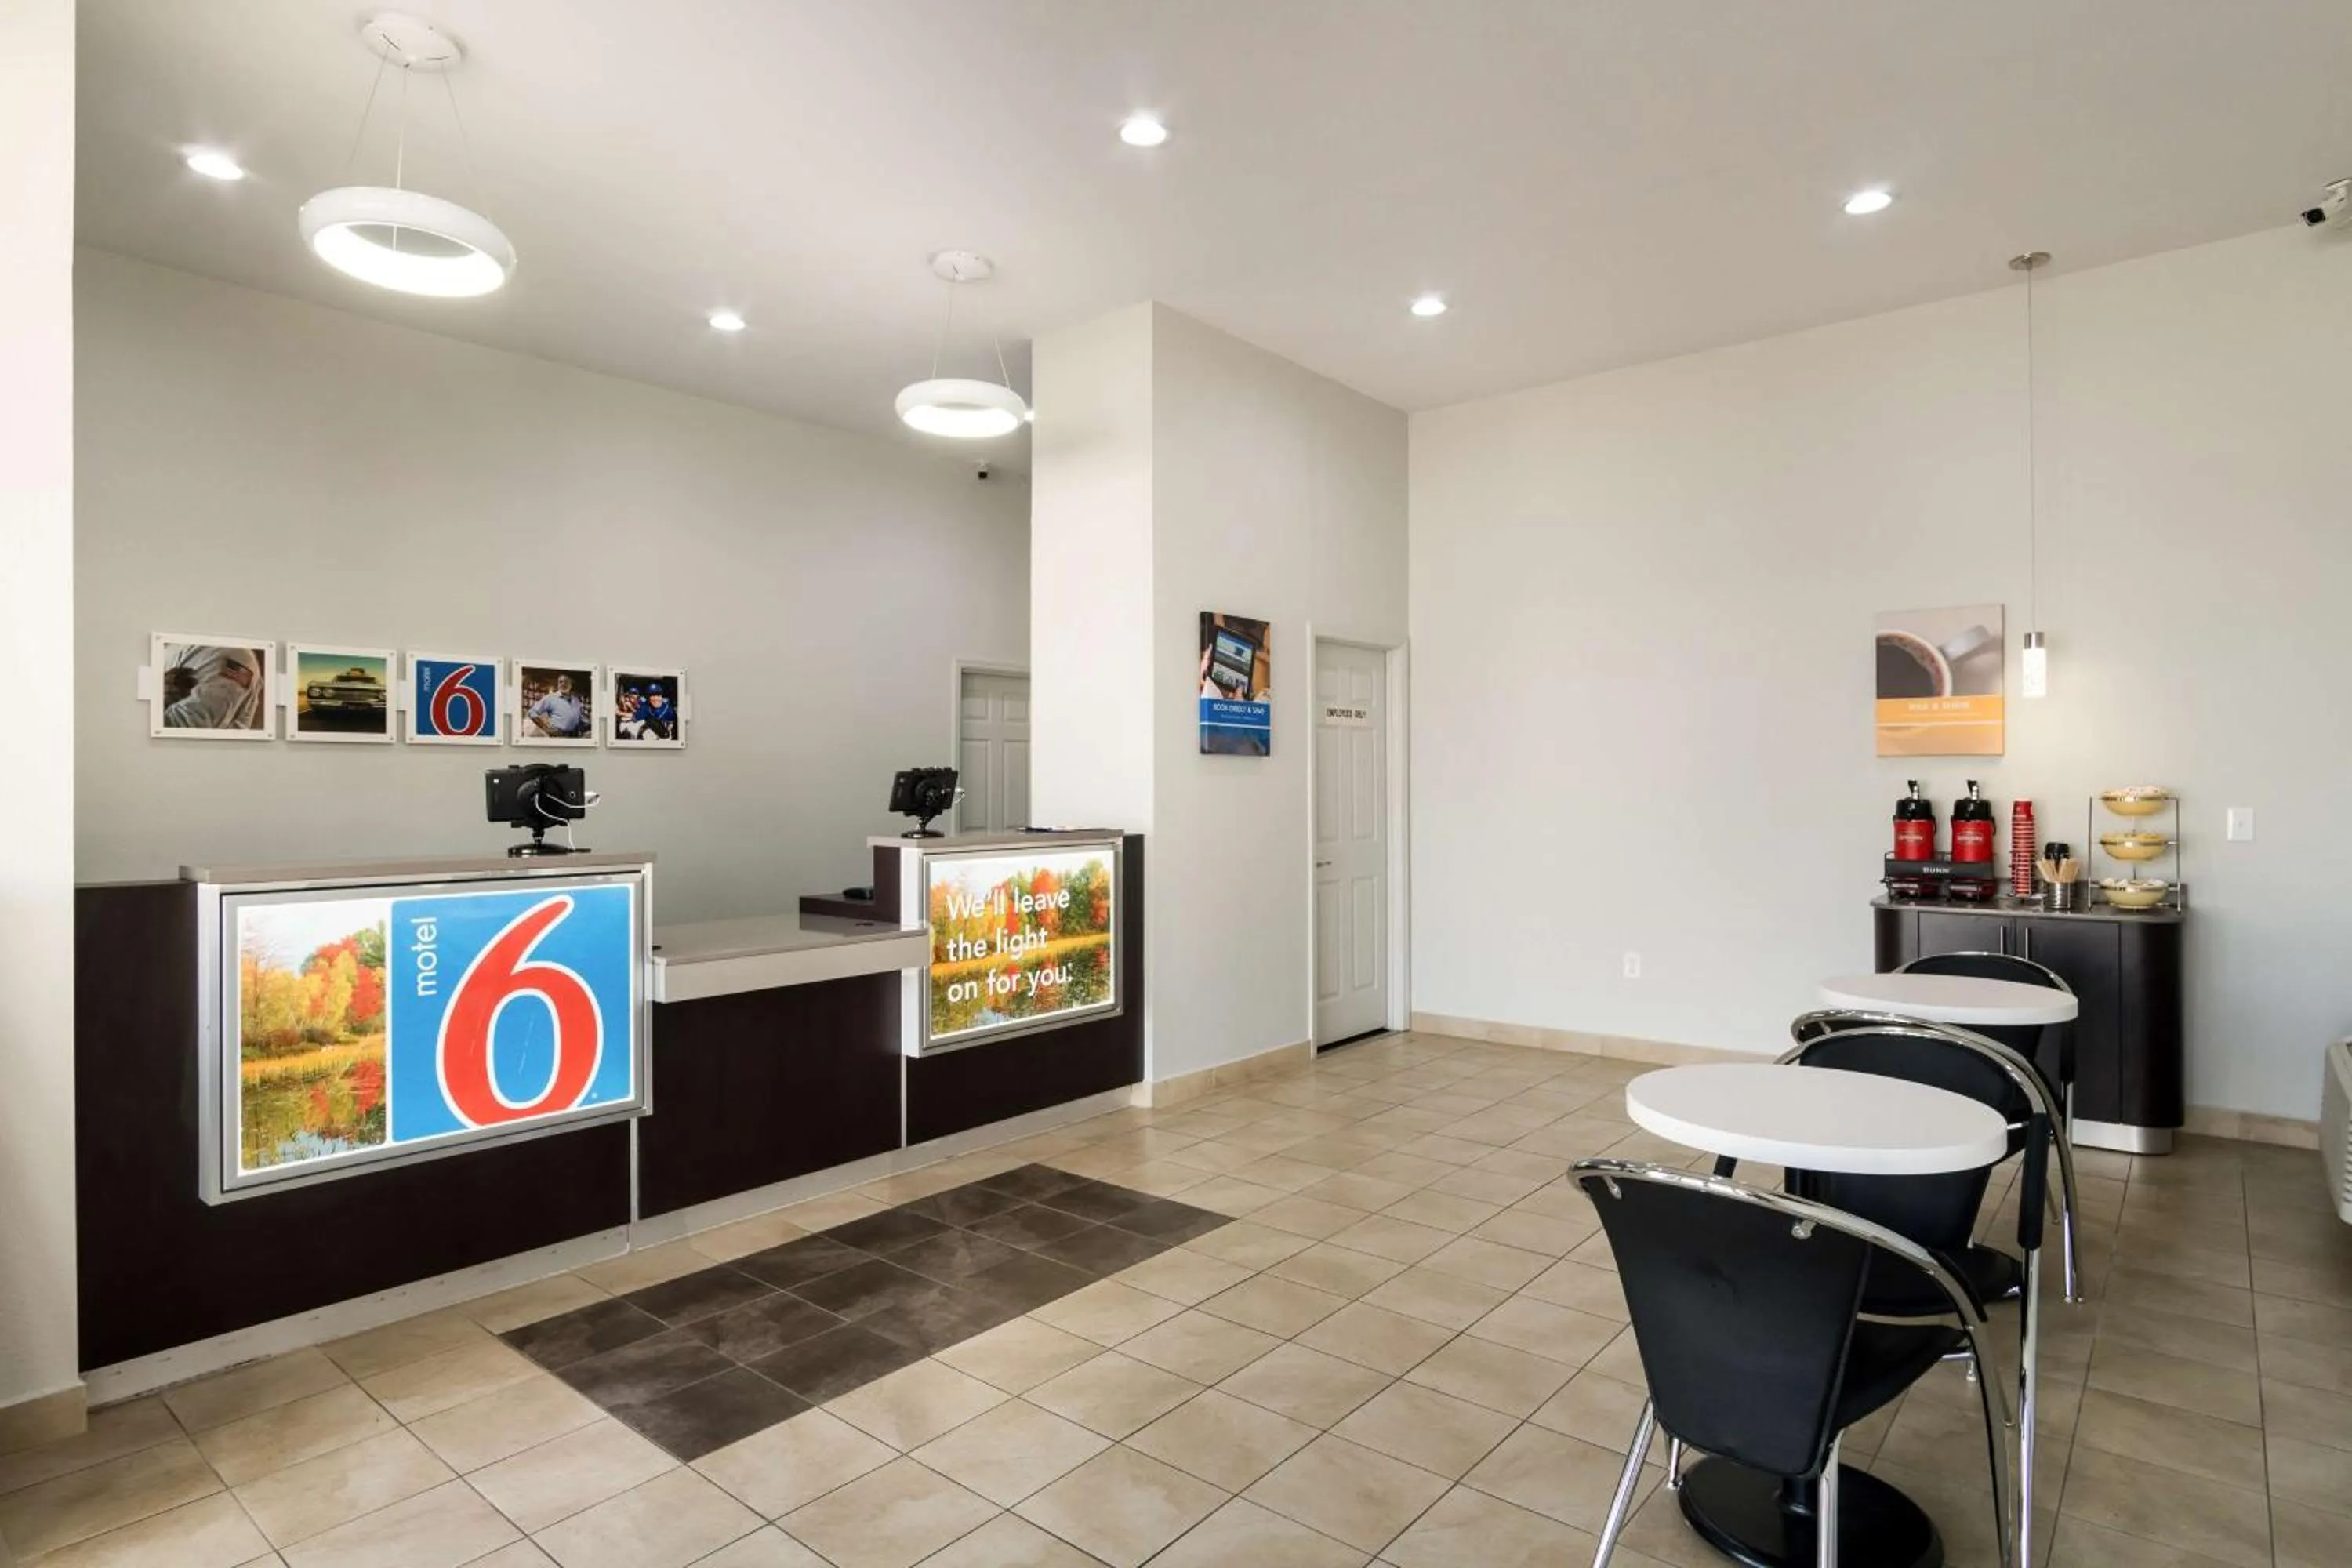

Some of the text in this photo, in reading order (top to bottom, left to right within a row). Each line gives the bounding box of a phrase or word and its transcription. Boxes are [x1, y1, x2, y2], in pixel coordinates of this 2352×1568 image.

[430, 664, 486, 737] 6
[946, 887, 1070, 920] We'll leave
[410, 916, 437, 996] motel
[946, 925, 1048, 962] the light
[436, 894, 604, 1131] 6
[947, 980, 978, 1004] on
[987, 968, 1022, 996] for
